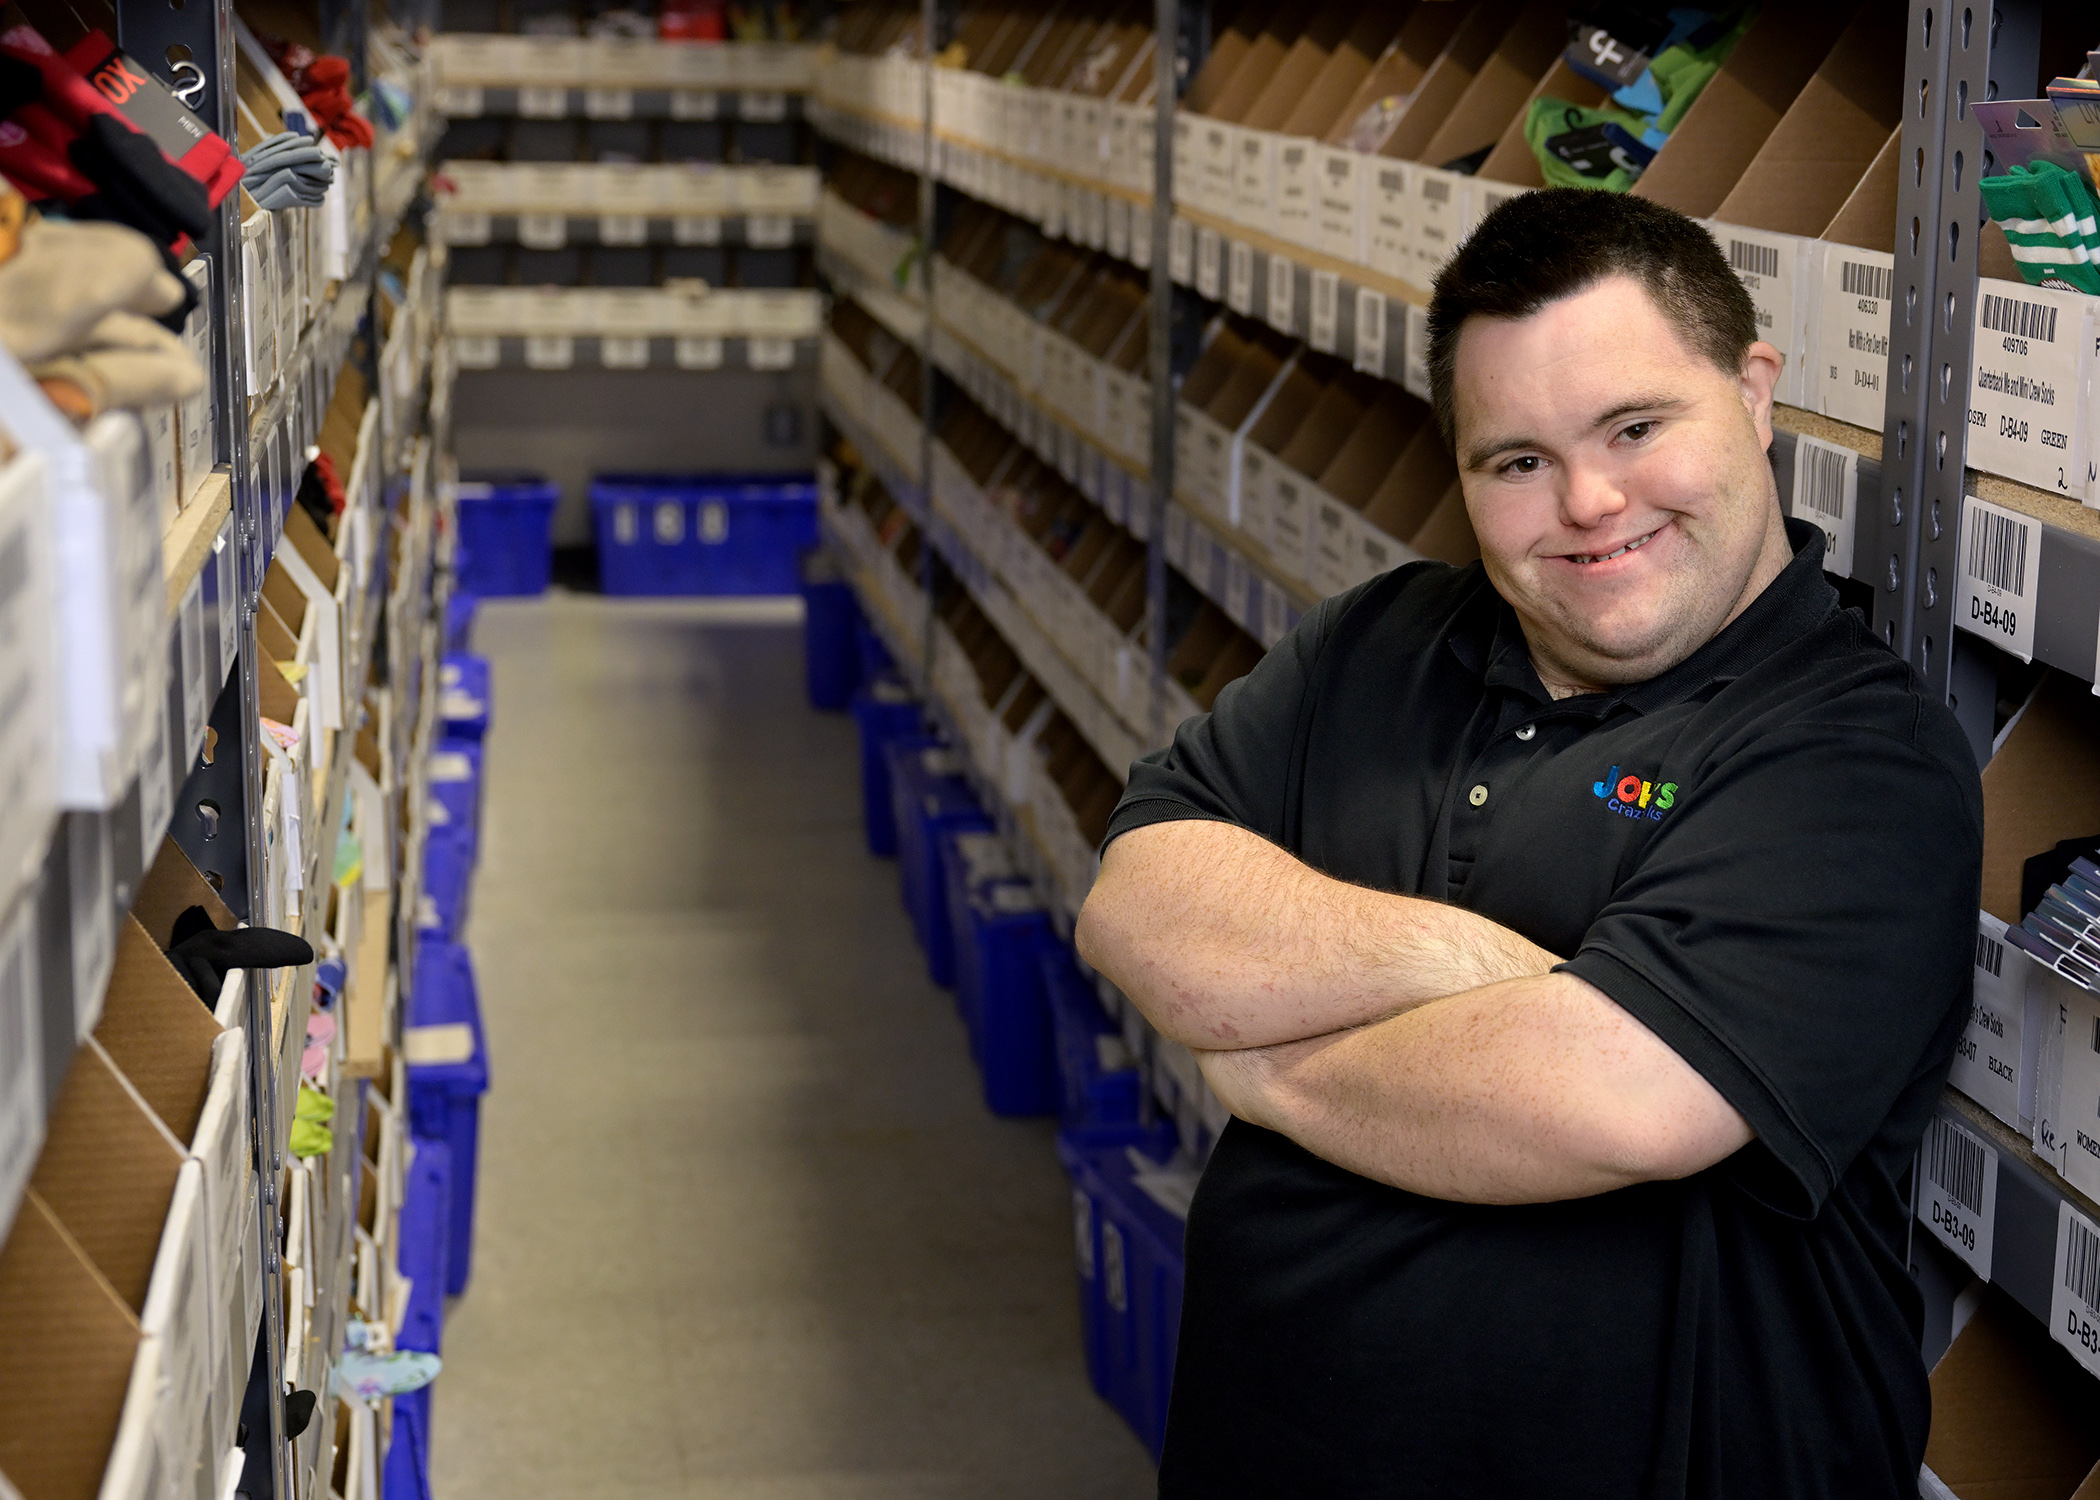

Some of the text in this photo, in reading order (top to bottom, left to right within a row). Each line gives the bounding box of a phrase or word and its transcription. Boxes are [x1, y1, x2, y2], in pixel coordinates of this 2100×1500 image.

[2002, 336, 2028, 356] 409706
[2000, 415, 2029, 443] D-B4-09
[2041, 428, 2068, 450] GREEN
[2058, 467, 2068, 490] 2
[1971, 595, 2016, 636] D-B4-09
[1989, 1055, 2014, 1083] BLACK
[1932, 1199, 1975, 1251] D-B3-09
